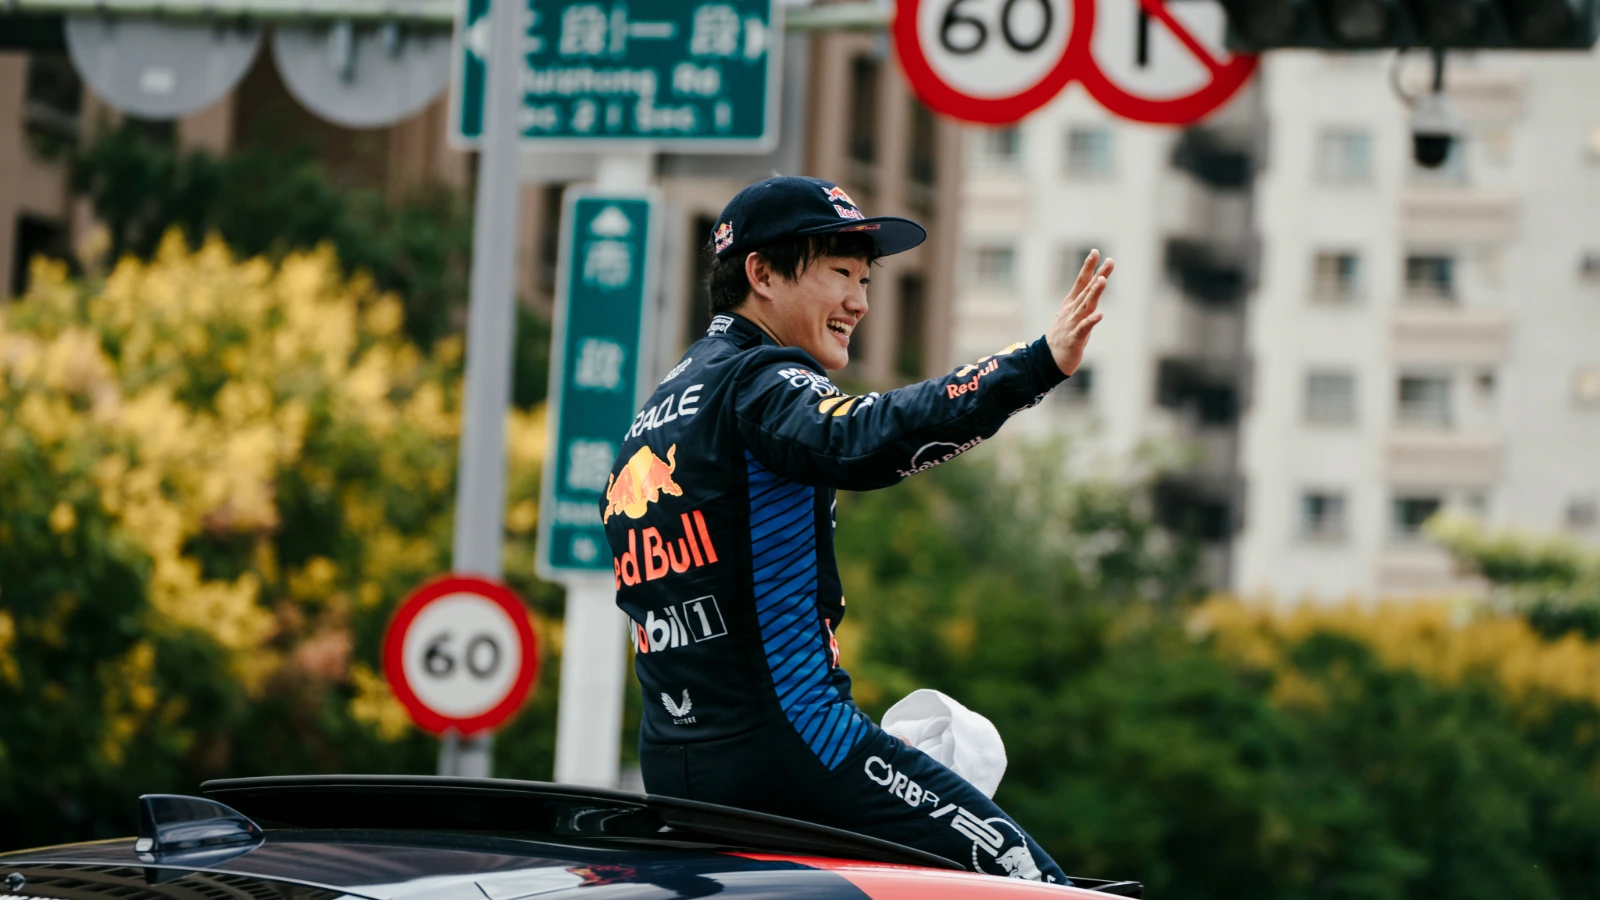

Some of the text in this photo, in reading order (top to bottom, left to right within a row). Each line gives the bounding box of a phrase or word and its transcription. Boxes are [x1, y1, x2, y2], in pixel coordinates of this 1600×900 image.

[939, 0, 1054, 54] 60
[623, 383, 705, 442] RACLE
[946, 375, 979, 400] Red
[614, 528, 642, 591] ed
[642, 510, 719, 581] Bull
[423, 631, 501, 681] 60
